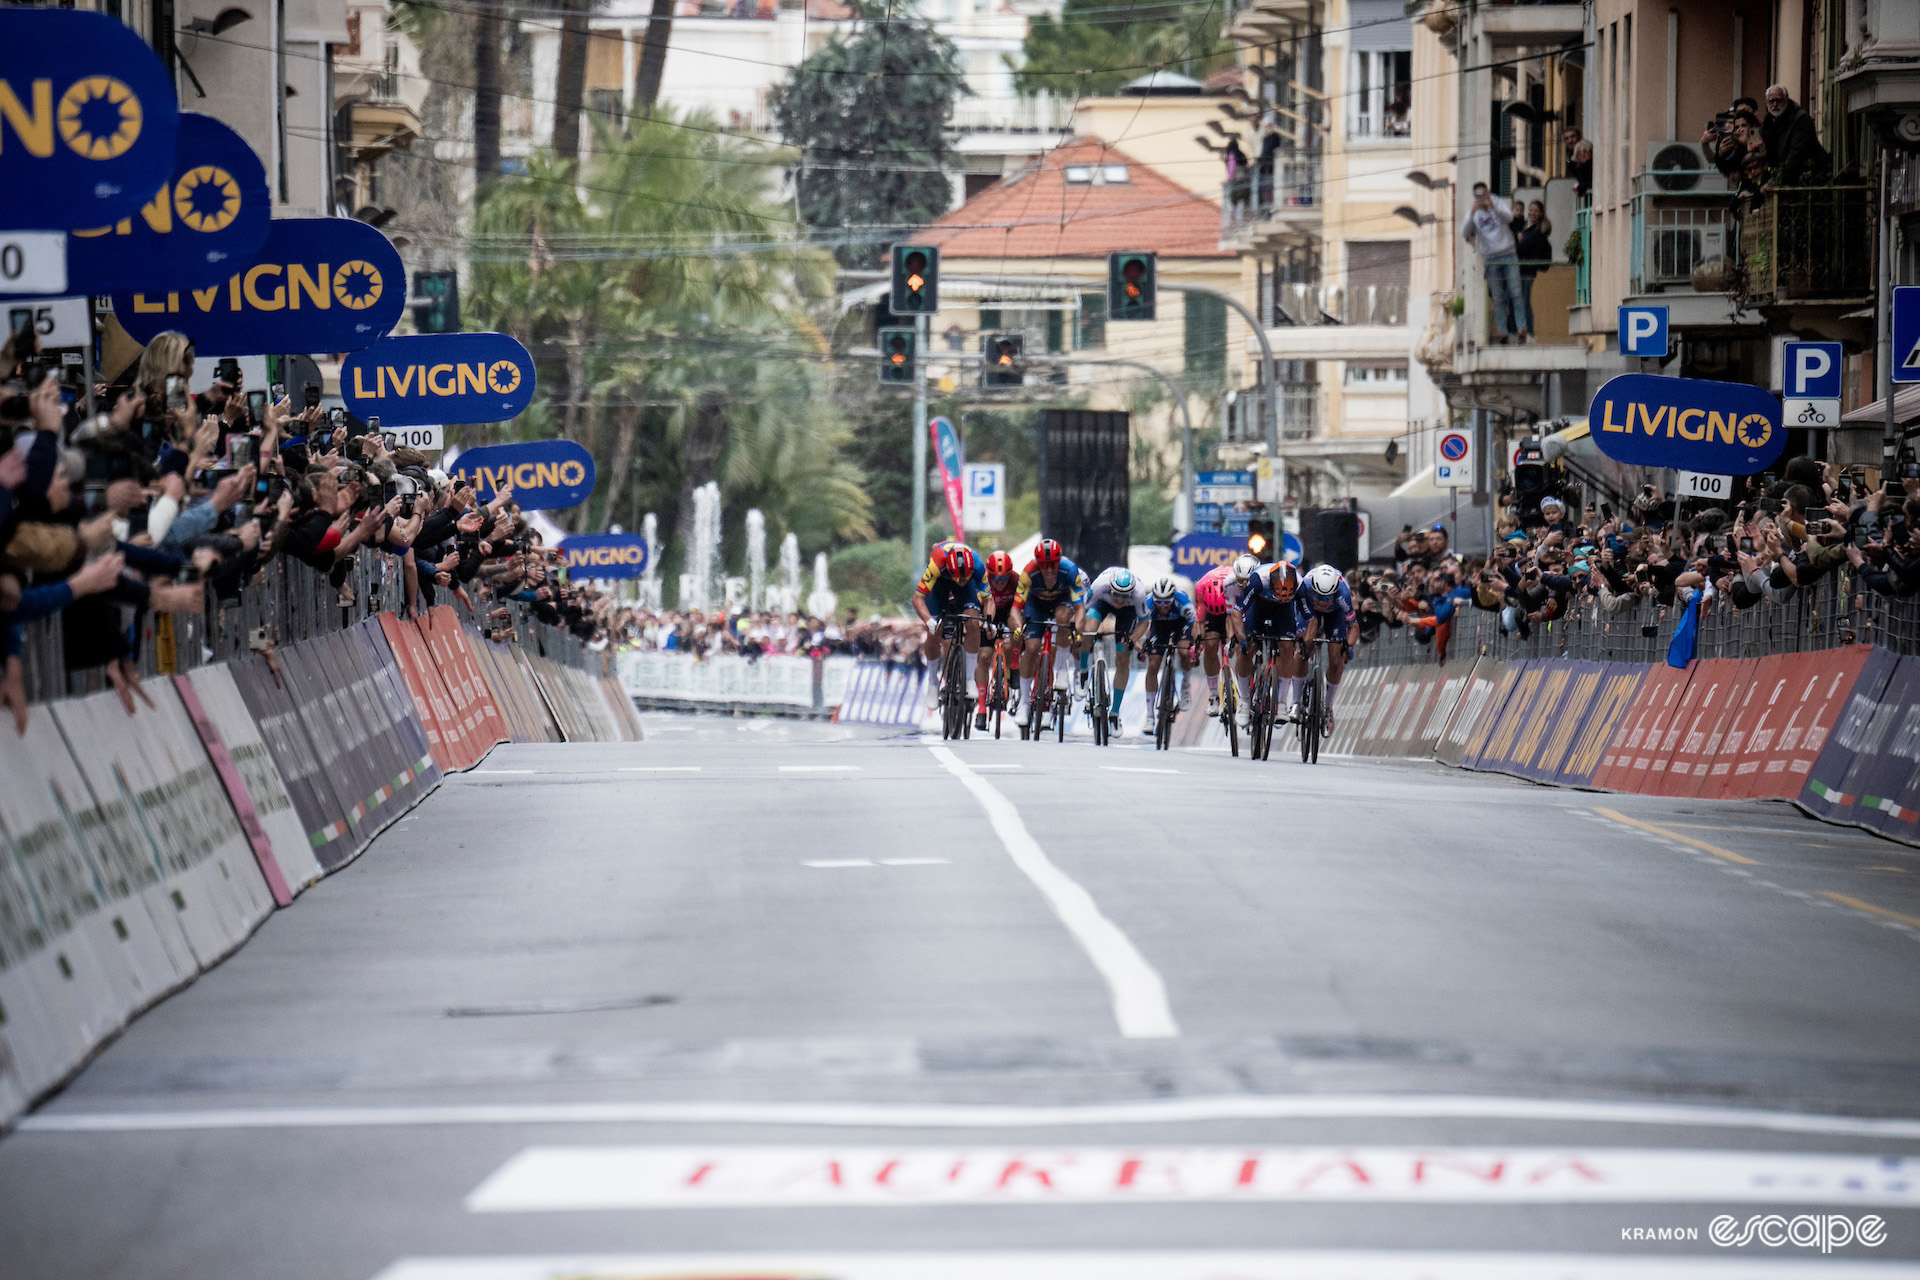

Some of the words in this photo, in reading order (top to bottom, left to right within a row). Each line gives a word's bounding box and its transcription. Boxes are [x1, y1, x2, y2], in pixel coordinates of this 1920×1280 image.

[353, 359, 522, 399] LIVIGNO
[1602, 400, 1773, 448] LIVIGNO
[401, 430, 433, 446] 100
[1689, 475, 1722, 494] 100
[1177, 547, 1245, 567] LIVIGN
